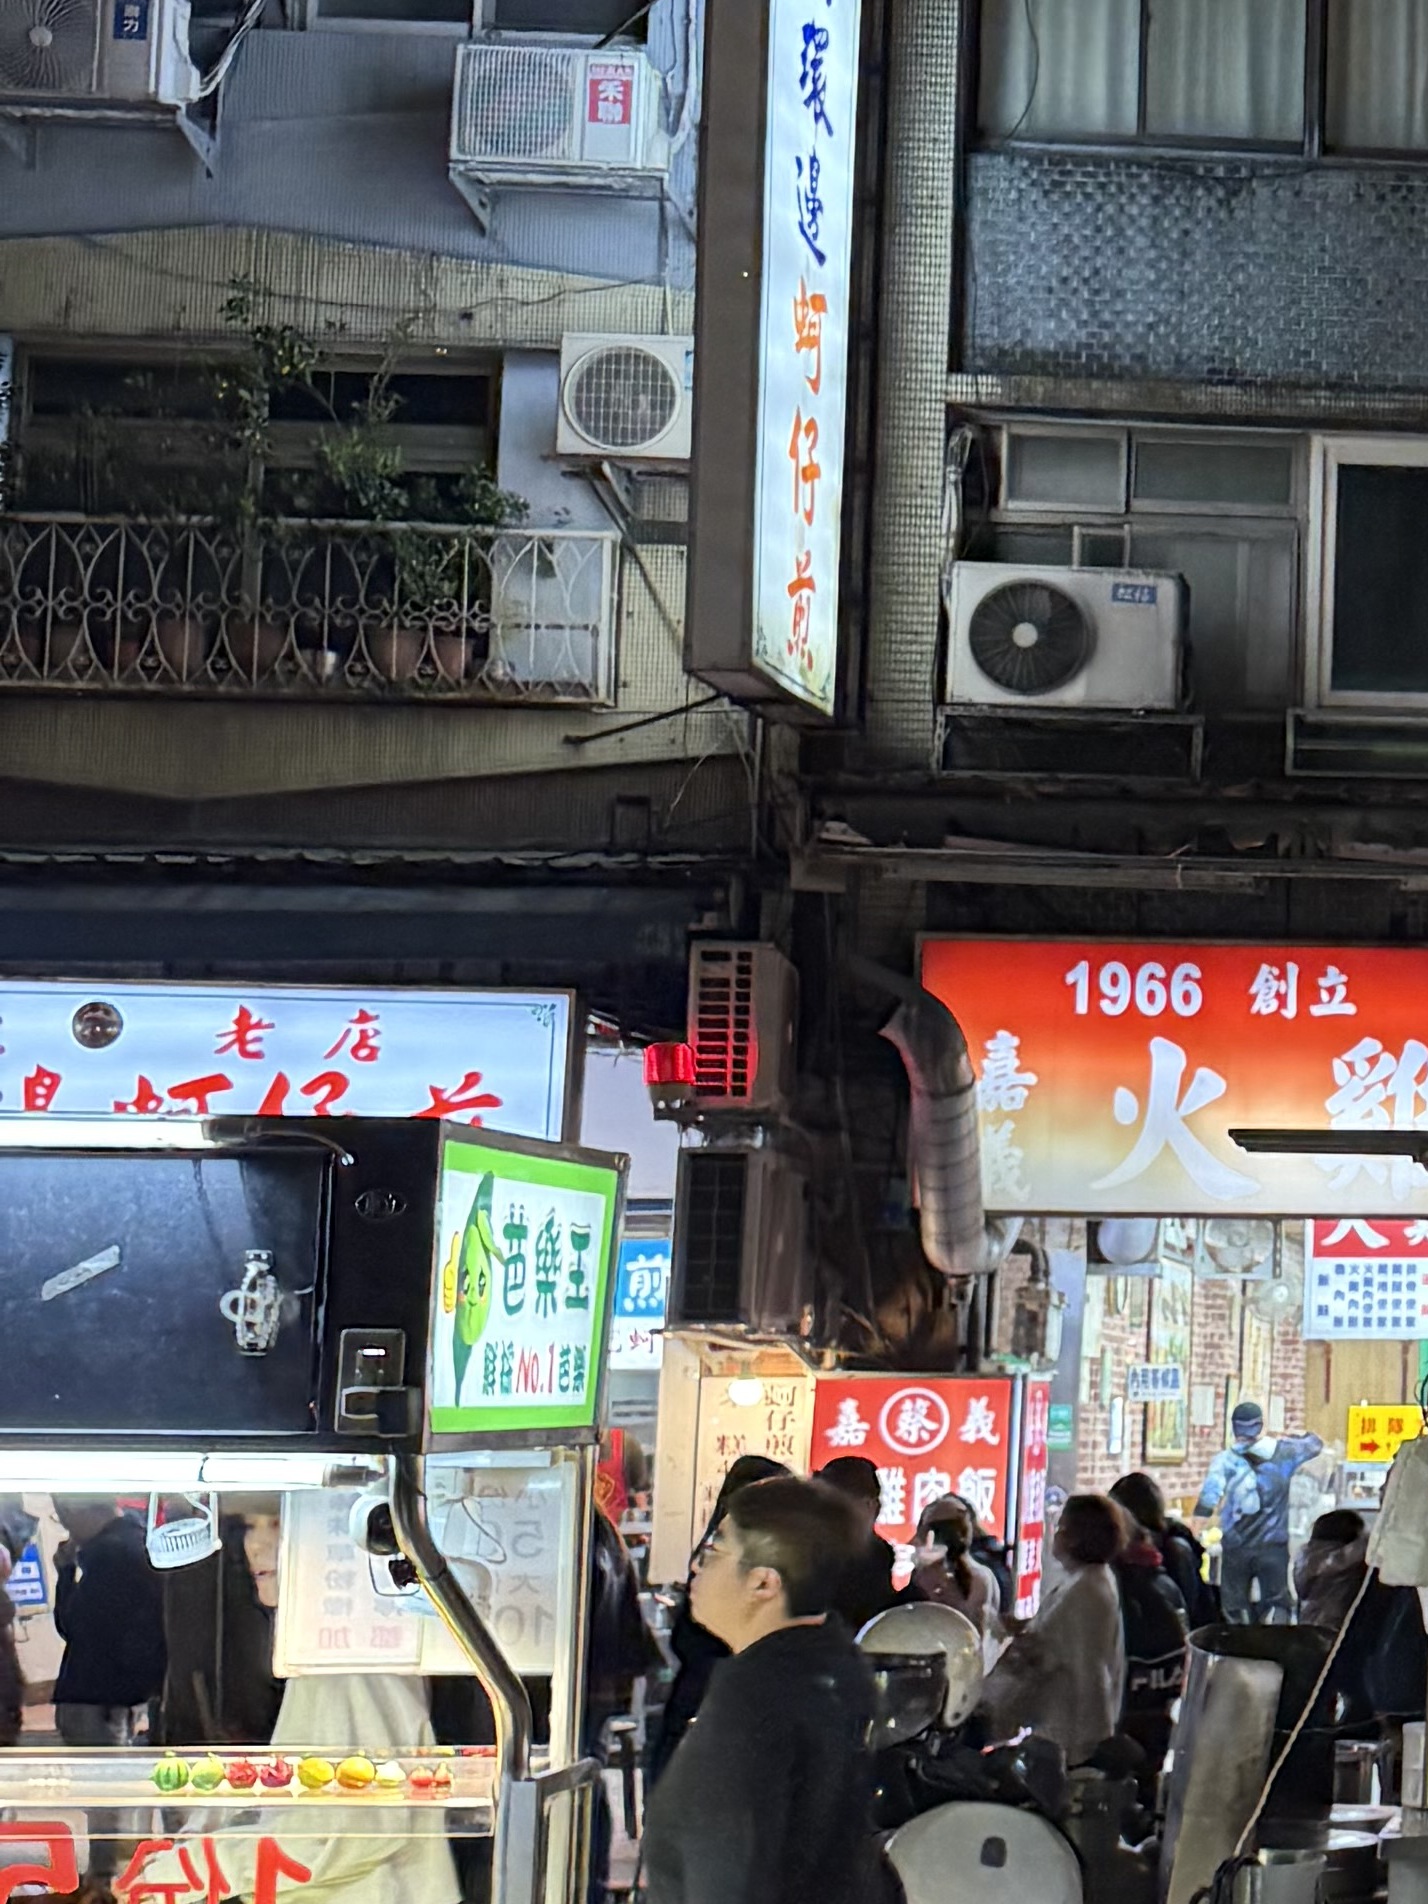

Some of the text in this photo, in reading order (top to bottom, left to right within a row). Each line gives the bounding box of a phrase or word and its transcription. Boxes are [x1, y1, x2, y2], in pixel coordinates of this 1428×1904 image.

[1065, 960, 1358, 1020] 1966 創立
[214, 1004, 381, 1062] 老店
[625, 1254, 671, 1312] 煎
